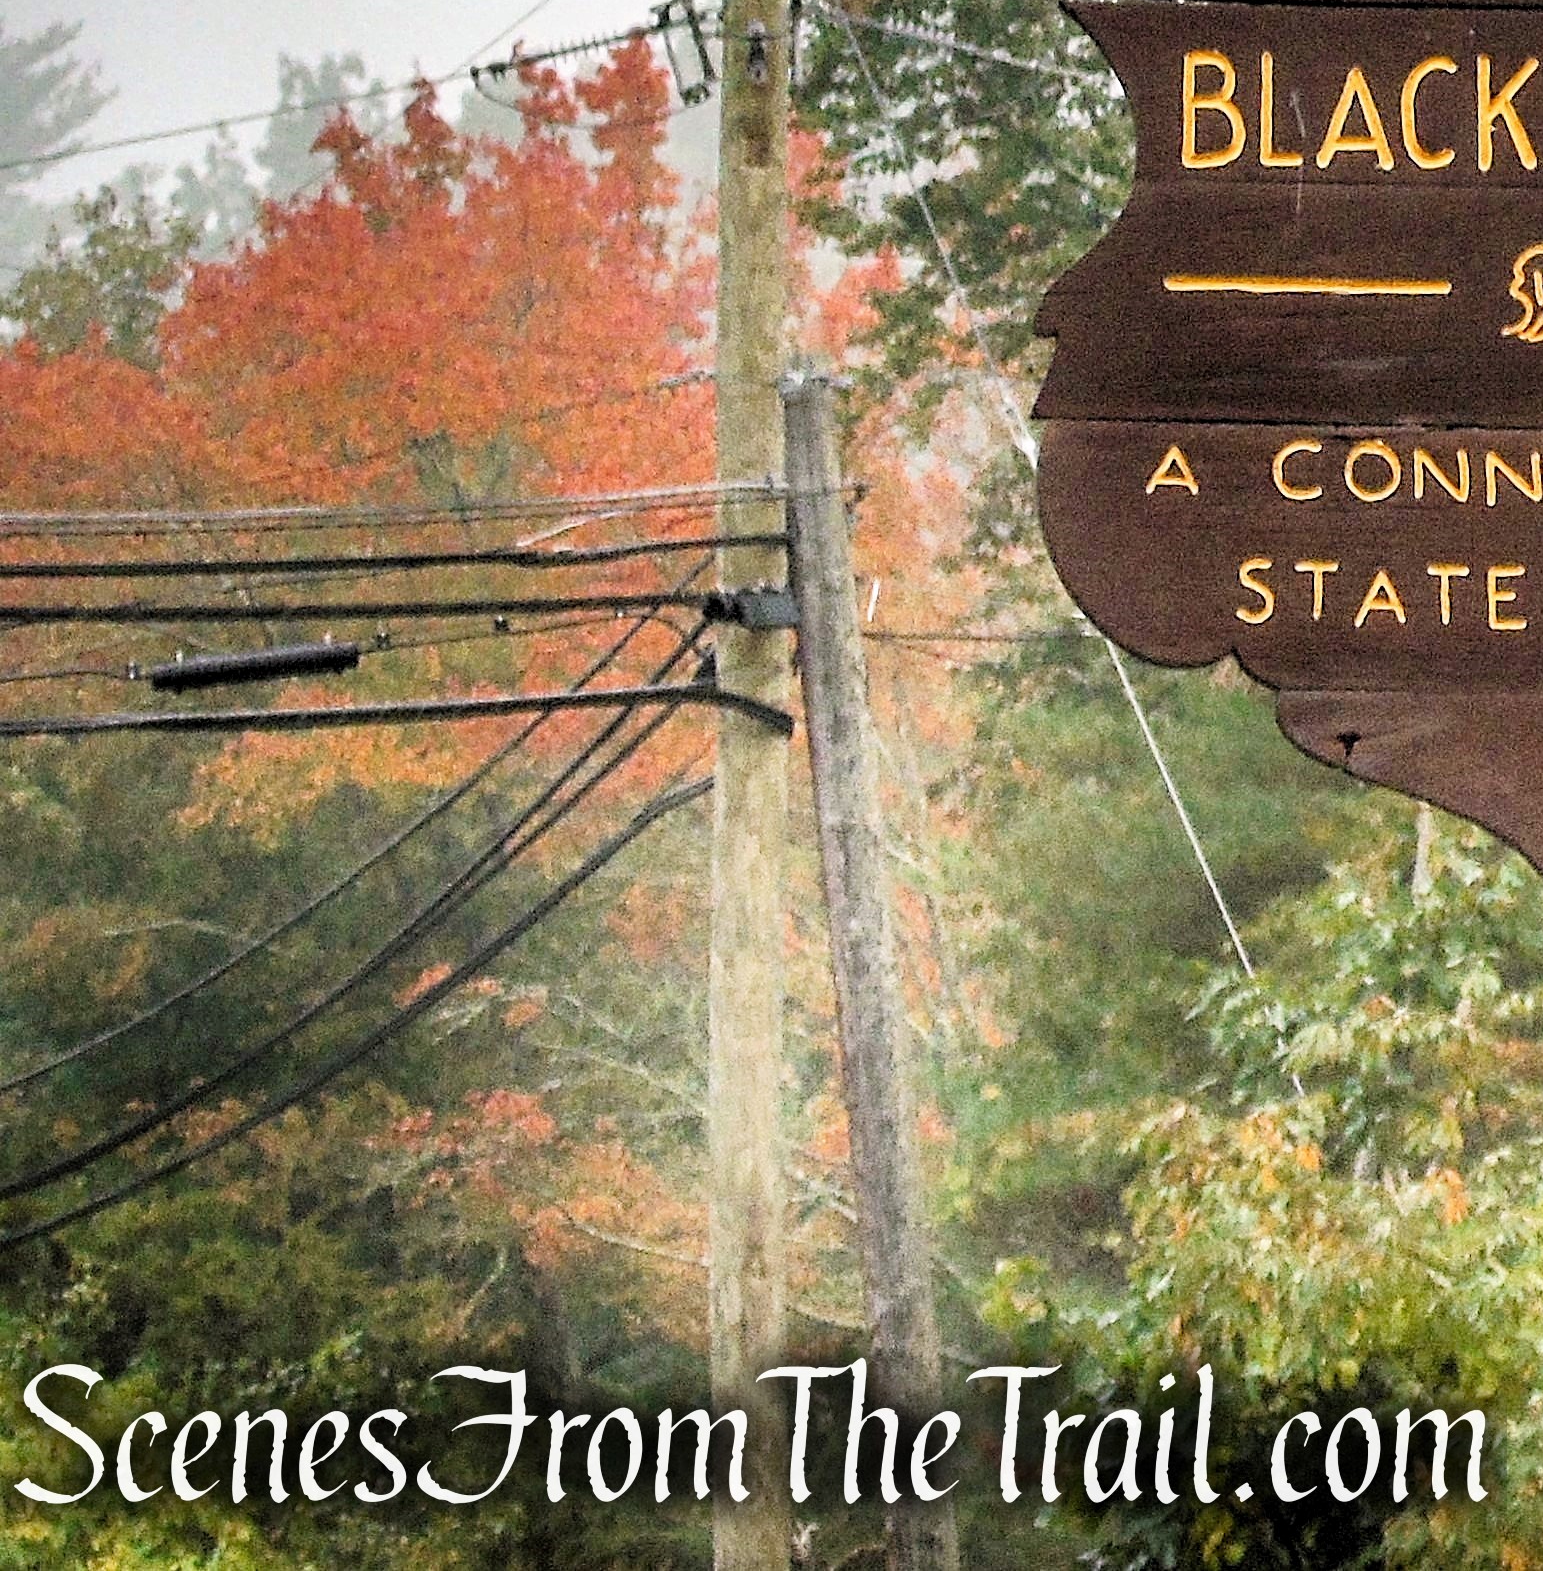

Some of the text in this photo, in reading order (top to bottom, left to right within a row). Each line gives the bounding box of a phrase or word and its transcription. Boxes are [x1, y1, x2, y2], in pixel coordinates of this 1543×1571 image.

[1180, 47, 1541, 175] BLACK
[1144, 443, 1200, 497] A
[1234, 555, 1529, 632] STATE
